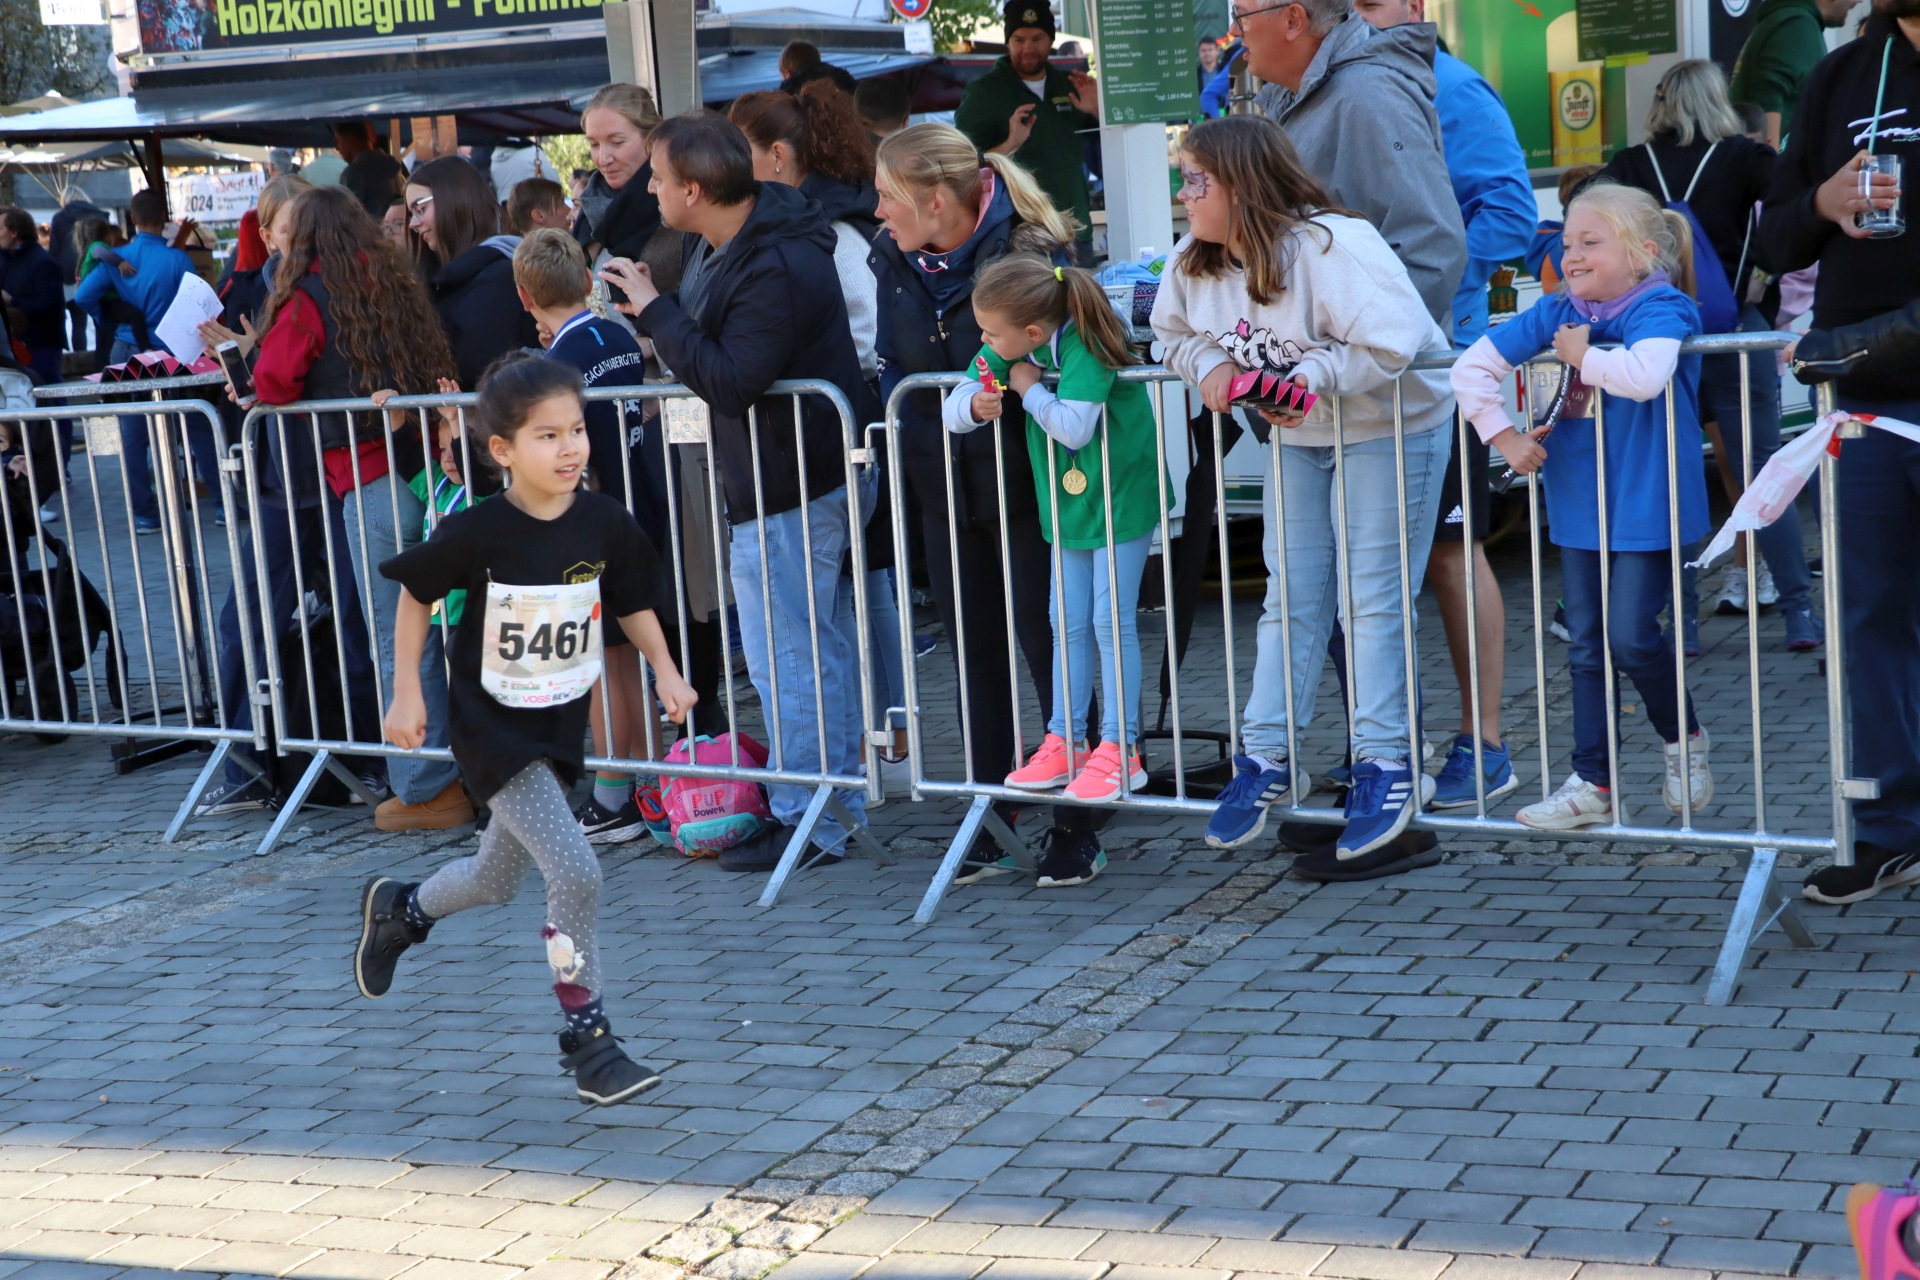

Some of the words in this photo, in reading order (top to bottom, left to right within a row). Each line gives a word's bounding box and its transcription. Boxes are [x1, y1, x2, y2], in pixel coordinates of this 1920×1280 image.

[185, 195, 213, 213] 2024
[498, 616, 590, 661] 5461
[522, 694, 551, 704] VOSS
[552, 692, 571, 701] BEW
[691, 789, 726, 809] PUP
